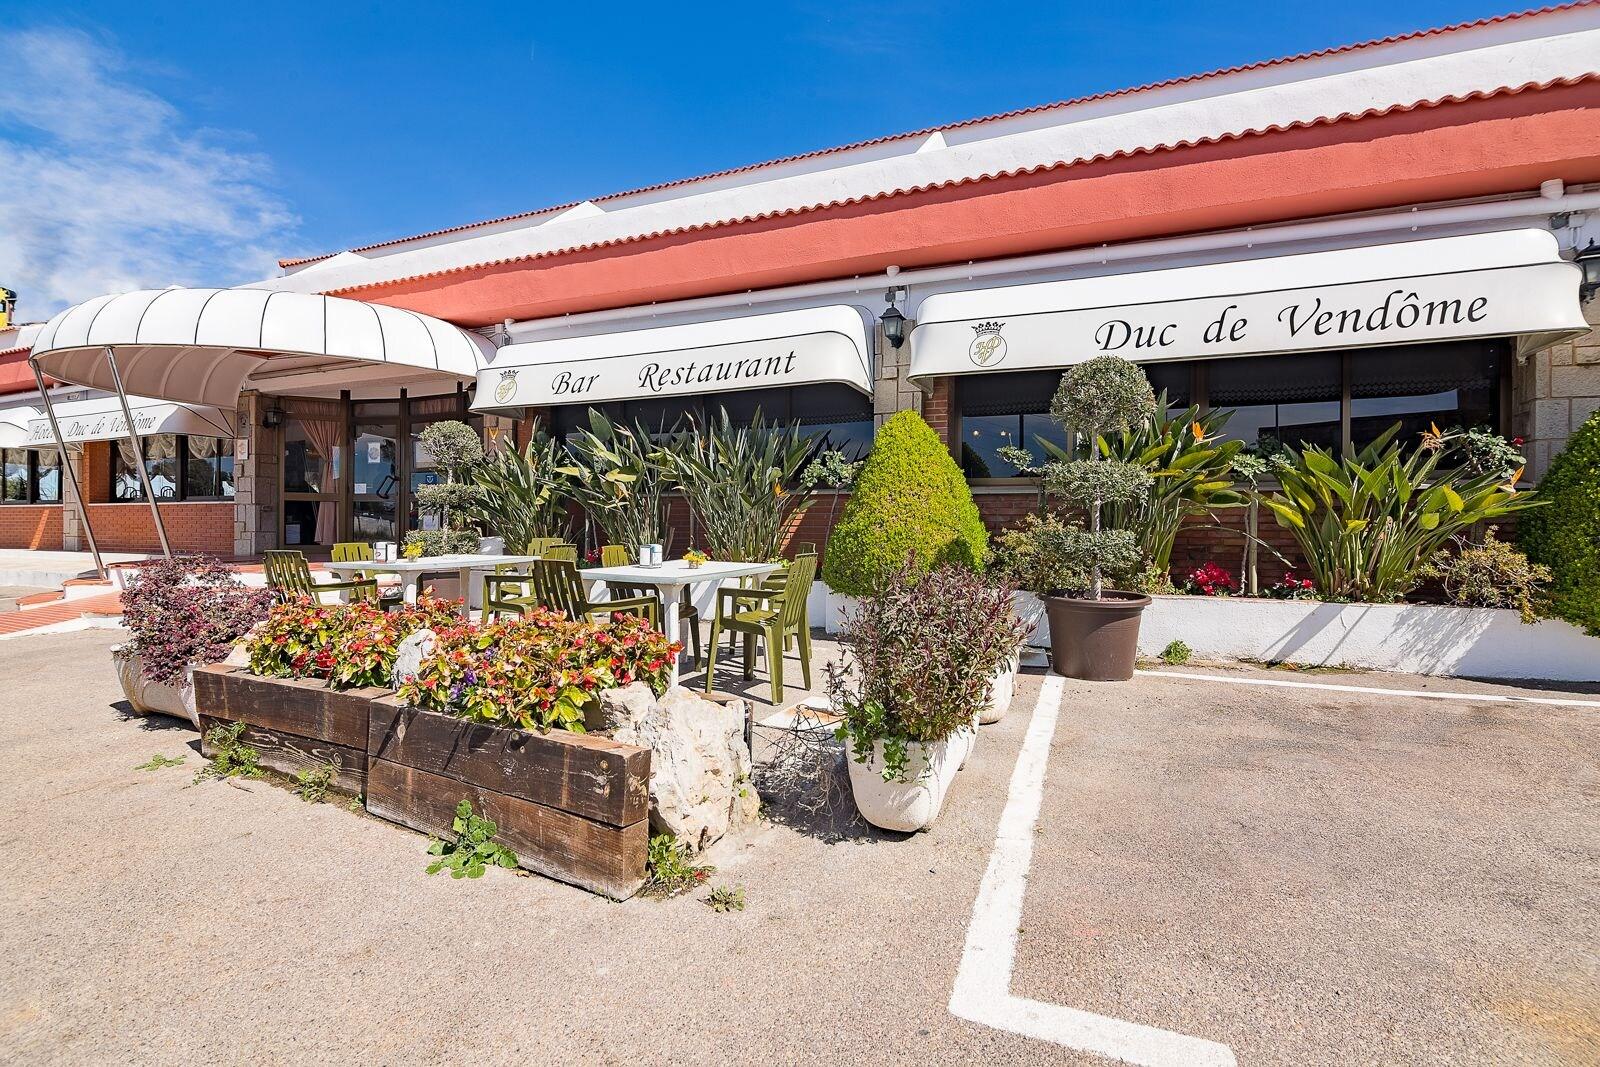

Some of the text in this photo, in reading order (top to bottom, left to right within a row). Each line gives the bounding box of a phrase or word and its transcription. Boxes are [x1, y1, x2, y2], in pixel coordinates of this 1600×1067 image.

[1094, 290, 1489, 351] Duc de Vendôme
[551, 371, 600, 396] Bar
[638, 350, 797, 392] Restaurant
[67, 421, 89, 437] Duc
[91, 416, 105, 435] de
